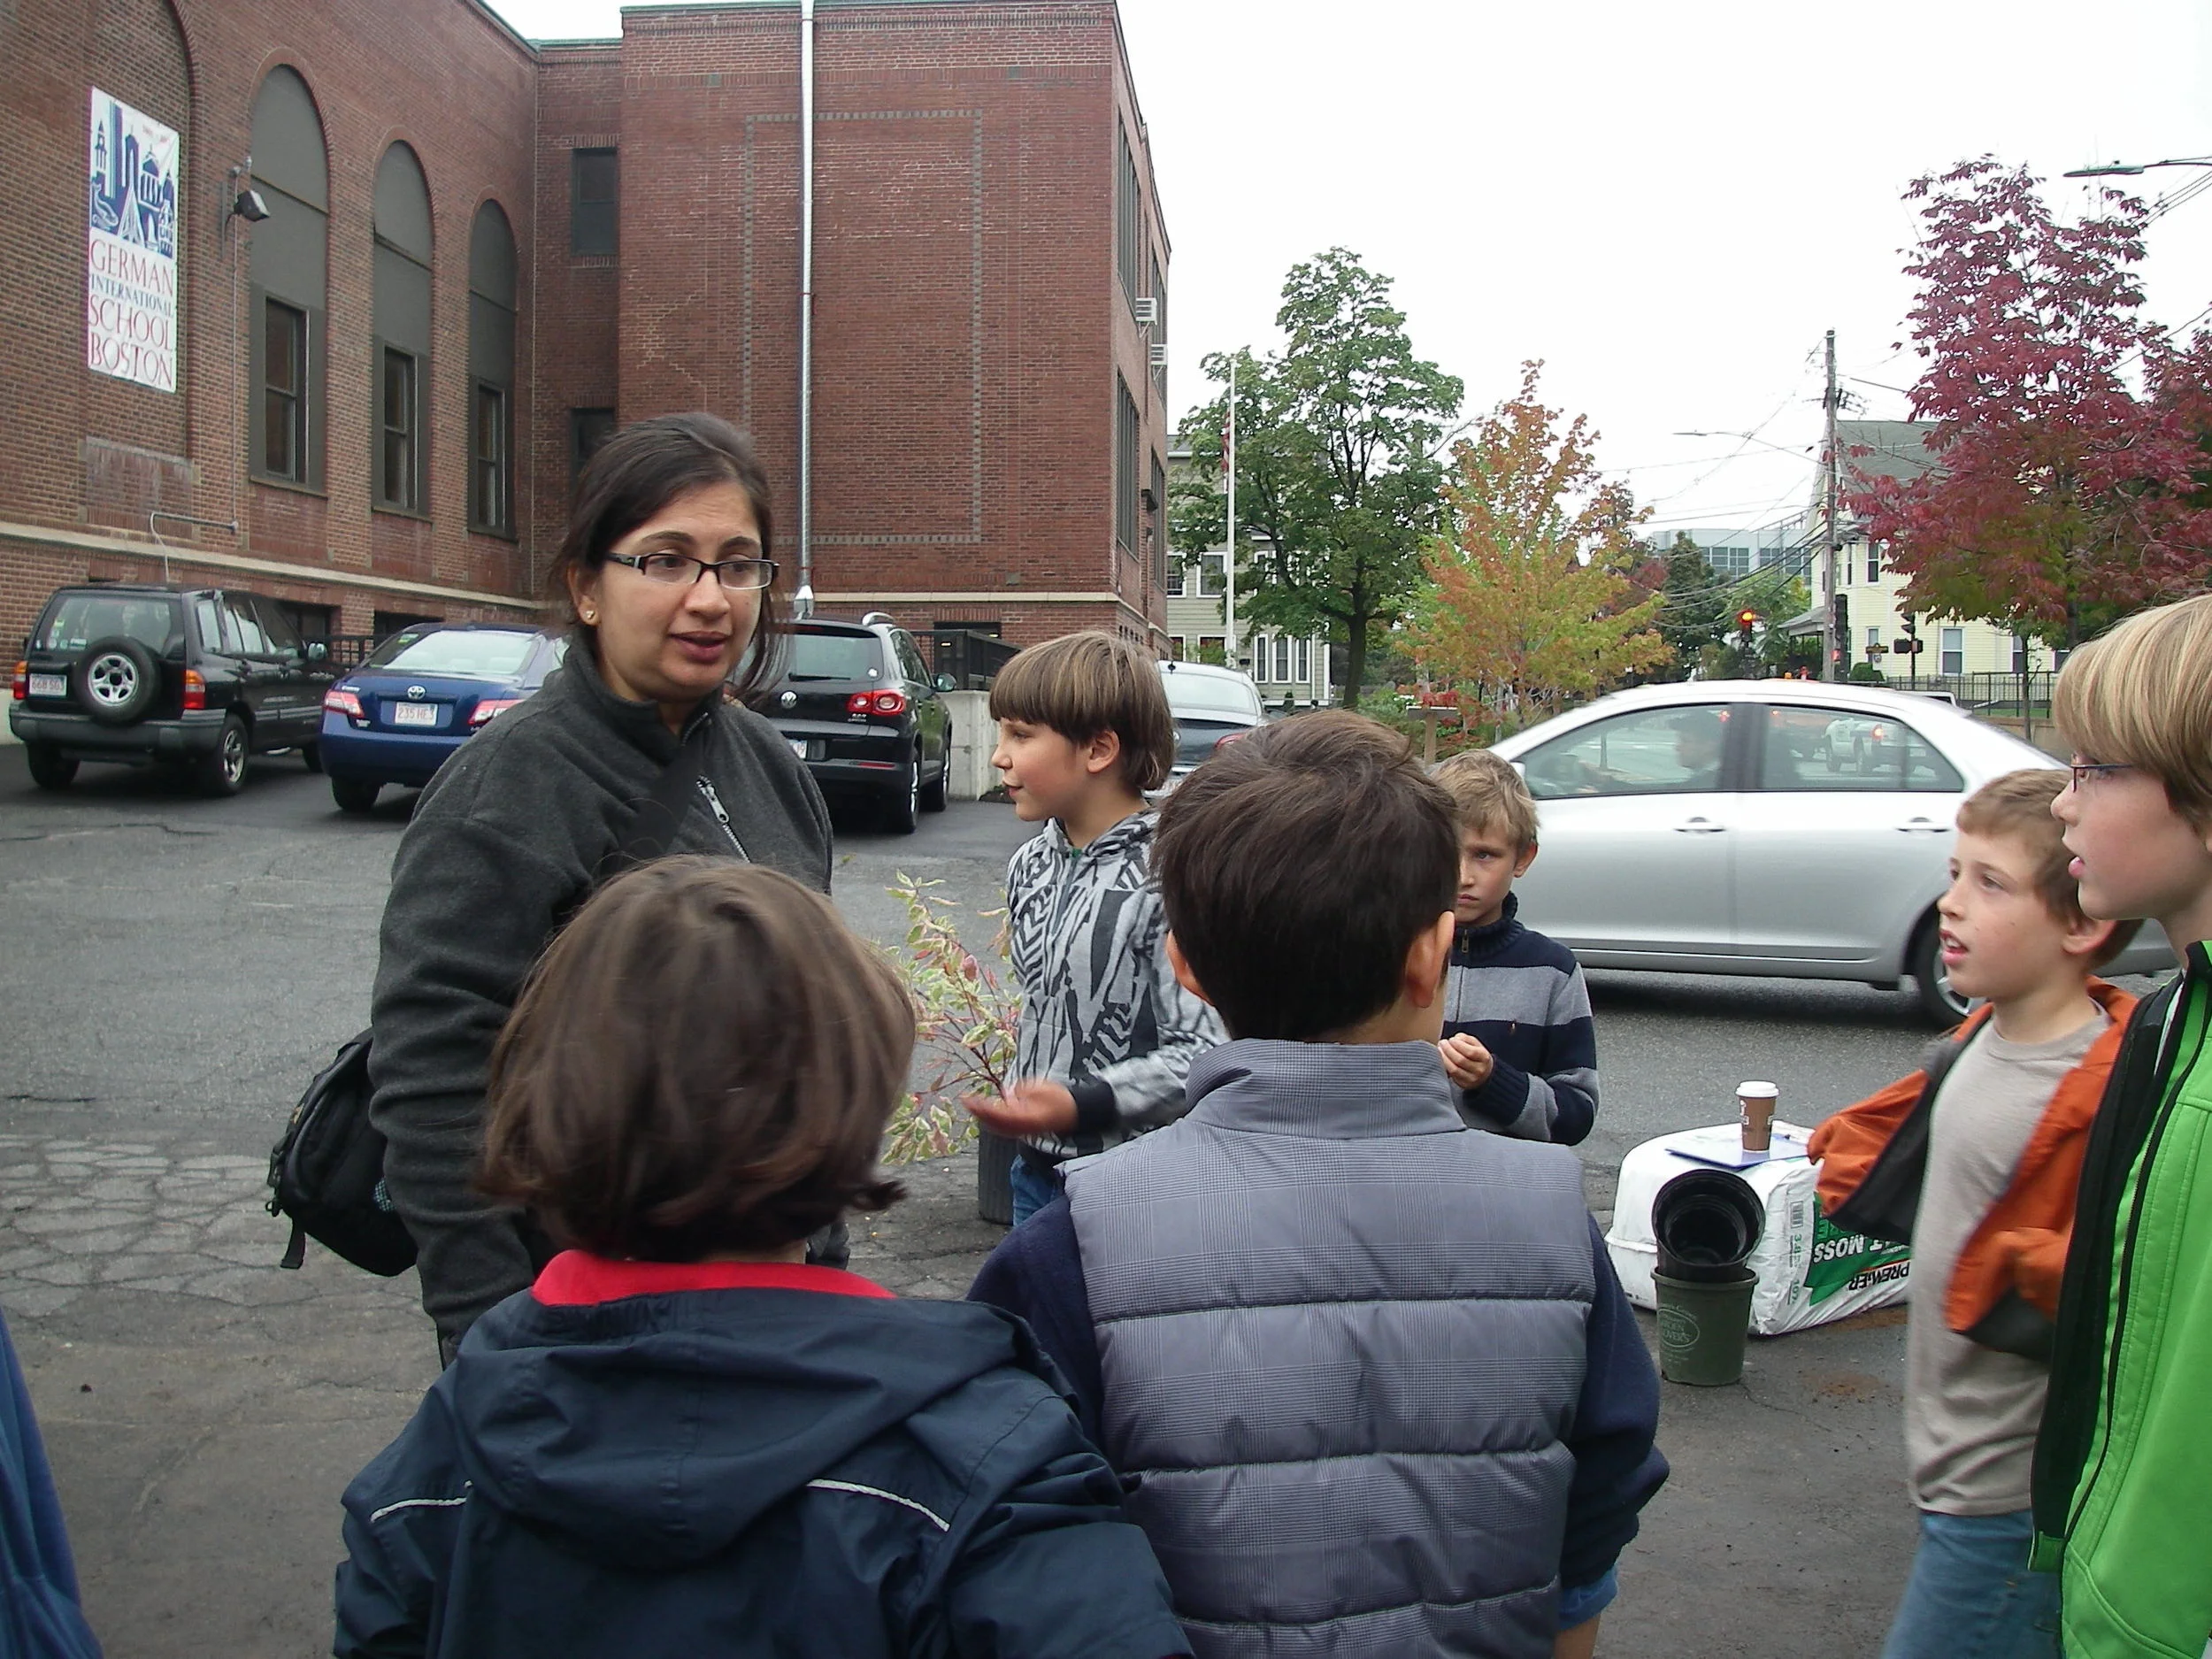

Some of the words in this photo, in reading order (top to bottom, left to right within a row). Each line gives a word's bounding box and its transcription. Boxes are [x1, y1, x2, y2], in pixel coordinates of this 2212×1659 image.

[91, 239, 173, 297] GERMAN
[91, 273, 173, 318] INTERNATIONAL
[88, 294, 173, 351] SCHOOL
[90, 332, 173, 387] BOSTON
[1814, 1233, 1864, 1263] MOSS
